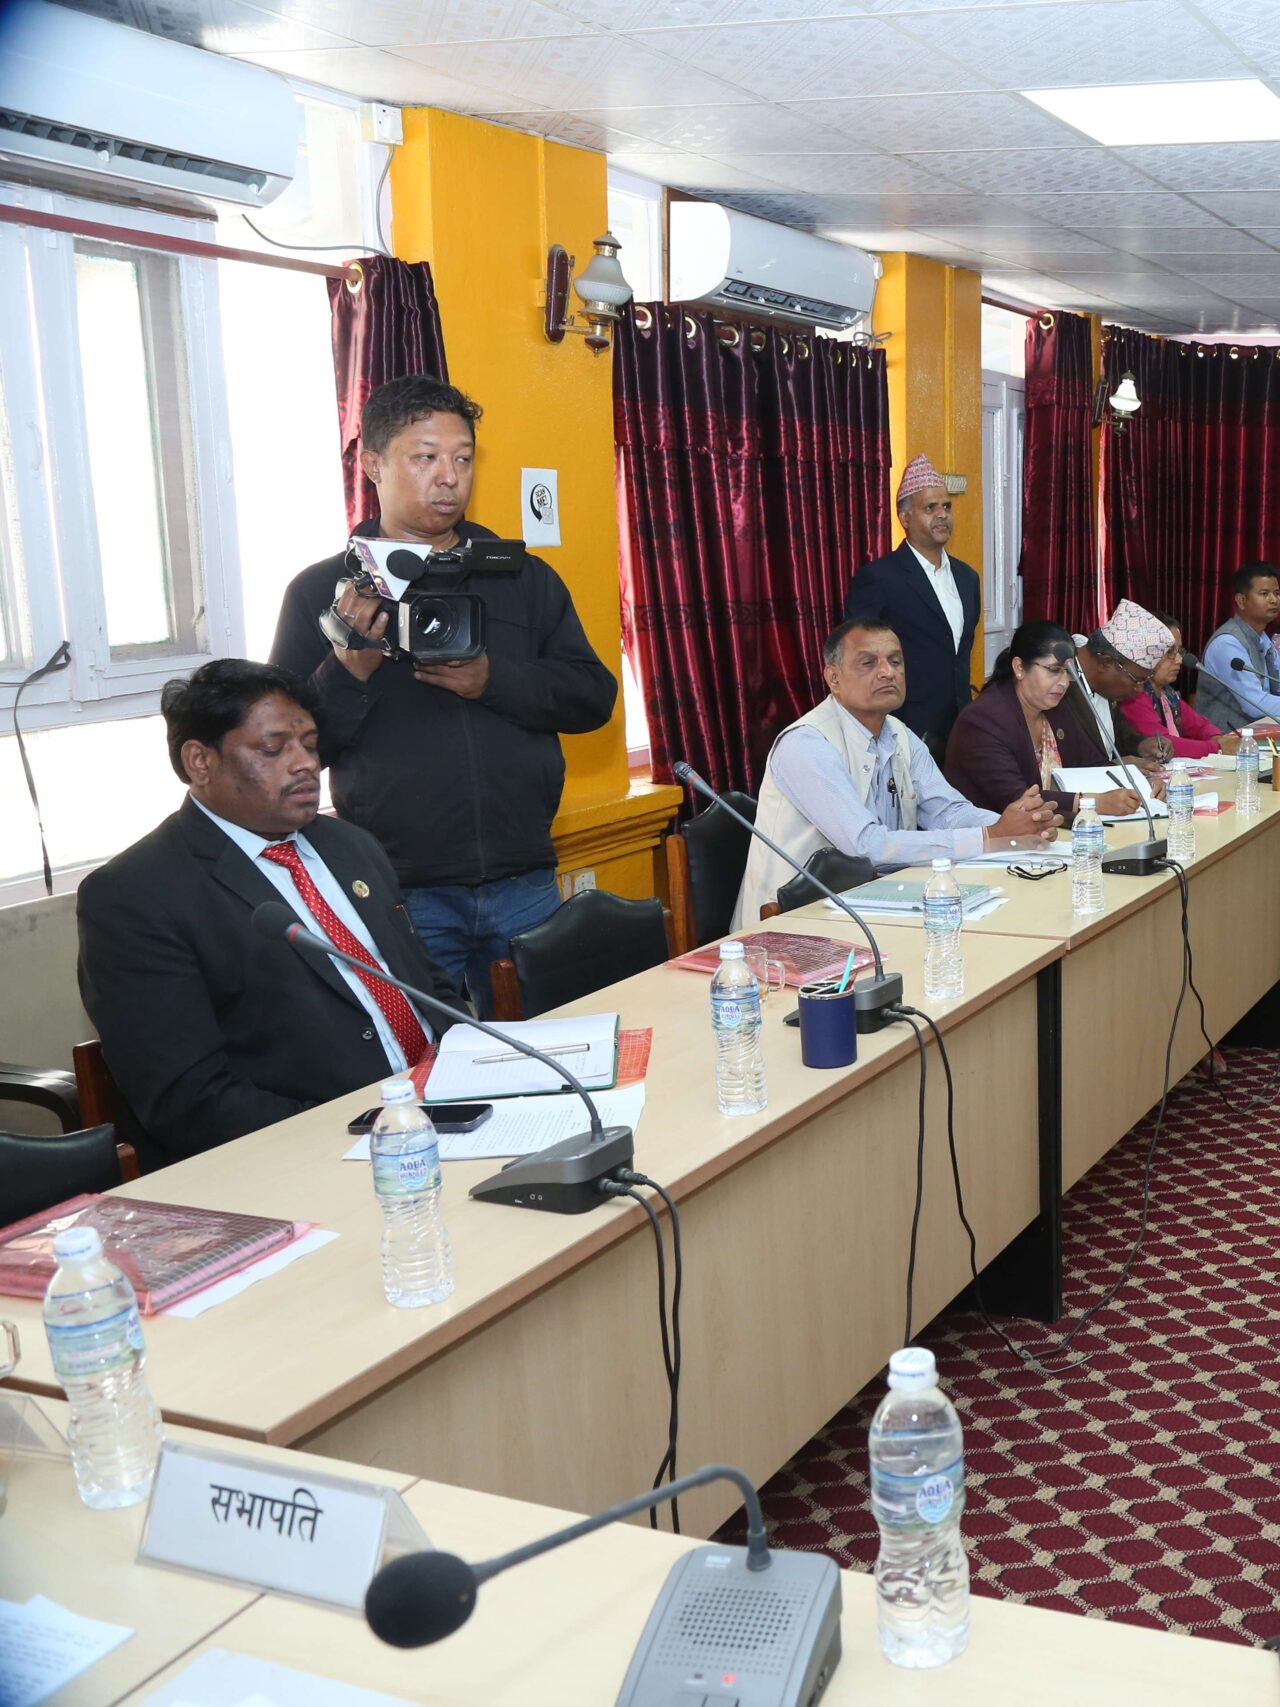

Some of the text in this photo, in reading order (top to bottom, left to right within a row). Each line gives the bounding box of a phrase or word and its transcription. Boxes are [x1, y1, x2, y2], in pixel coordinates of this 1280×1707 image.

[535, 488, 545, 497] SCAN
[399, 1158, 426, 1172] AQUA
[918, 1479, 951, 1499] AQUA
[209, 1483, 325, 1543] सभापति
